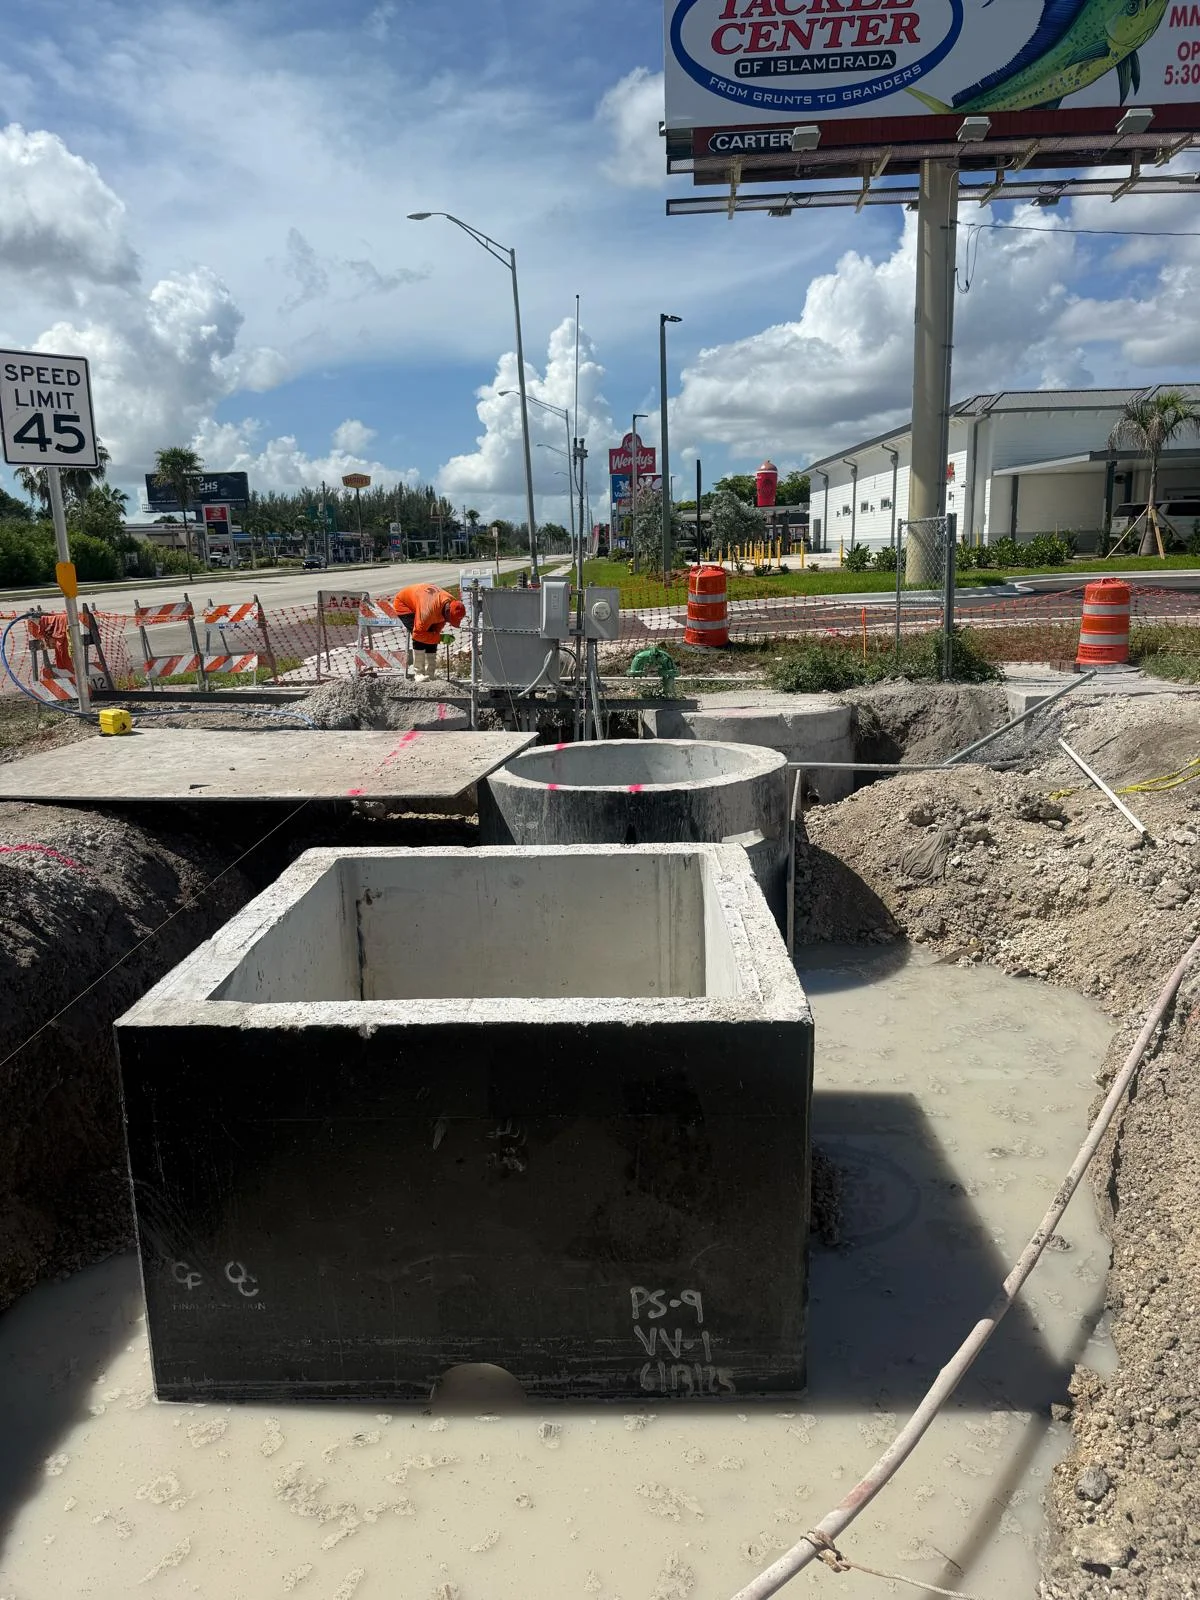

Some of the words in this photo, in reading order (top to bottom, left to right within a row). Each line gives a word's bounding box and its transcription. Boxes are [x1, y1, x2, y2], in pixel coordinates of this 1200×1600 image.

[711, 12, 921, 56] CENTER
[739, 61, 761, 75] OF
[770, 53, 893, 73] ISLAMORADA
[709, 76, 748, 99] FROM
[753, 92, 812, 105] GRUNTS
[817, 93, 836, 103] TO
[842, 63, 923, 101] GRANDERS
[4, 363, 81, 387] SPEED
[15, 388, 75, 410] LIMIT
[13, 412, 86, 454] 45
[92, 677, 107, 689] 12
[630, 1286, 704, 1323] PS-9
